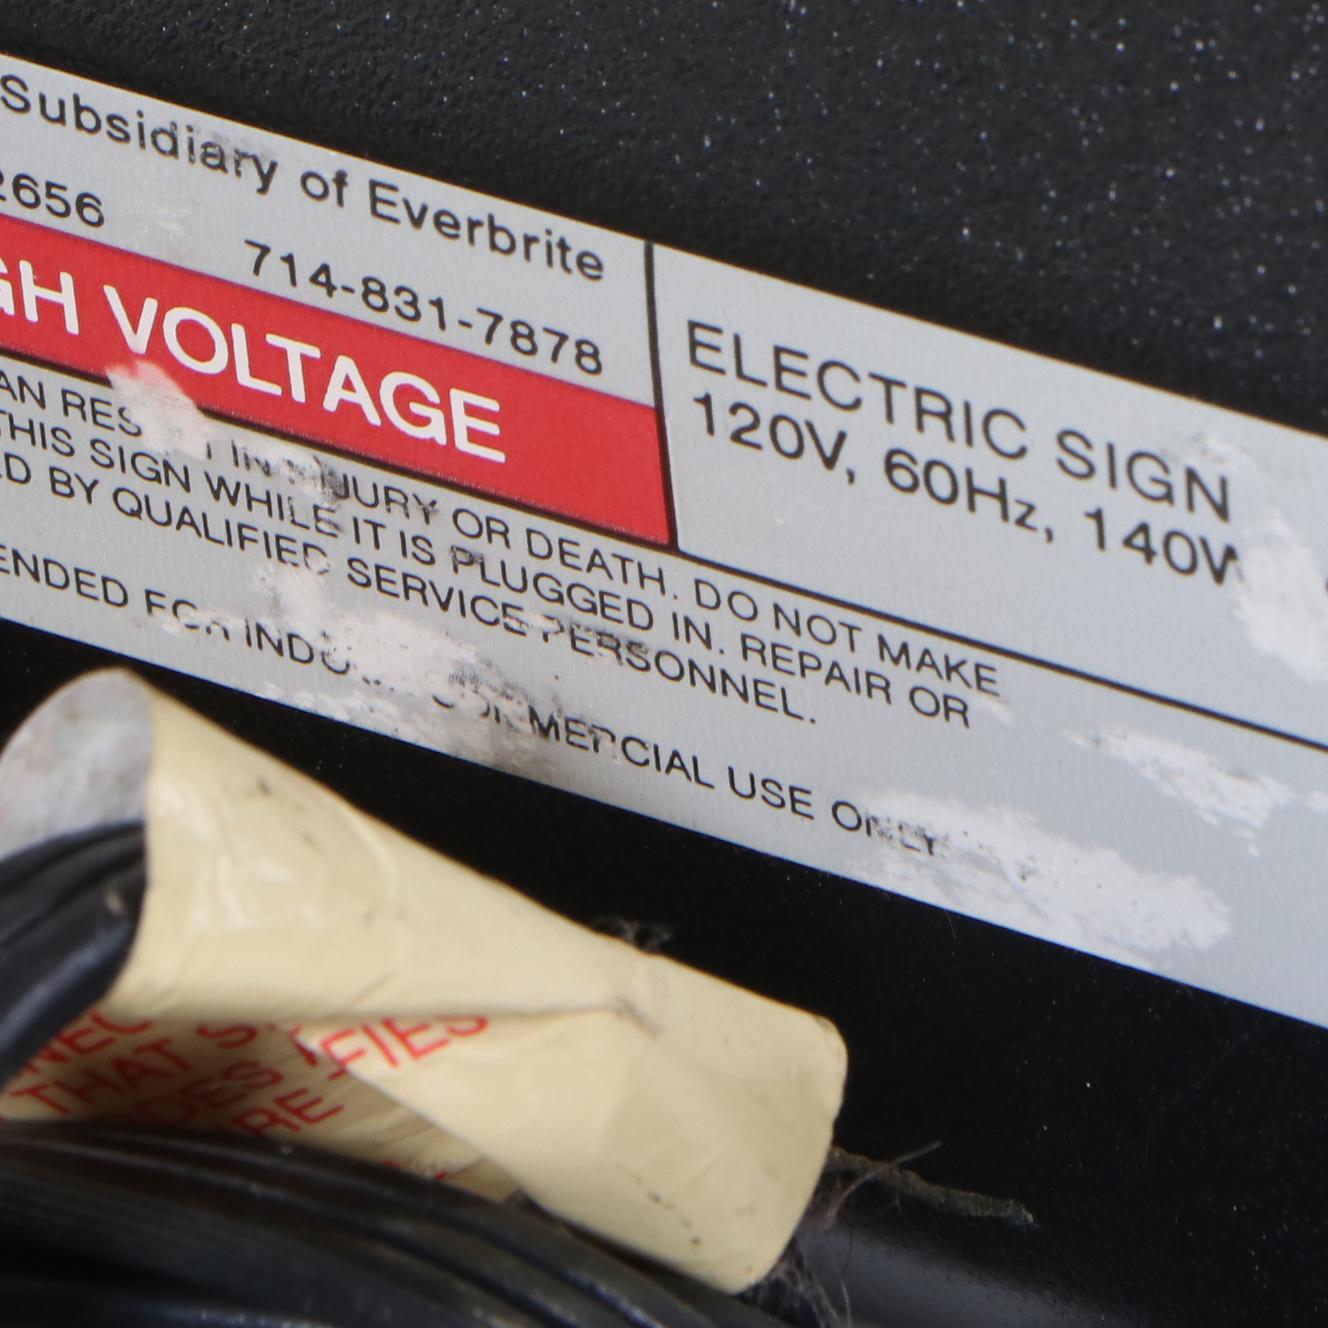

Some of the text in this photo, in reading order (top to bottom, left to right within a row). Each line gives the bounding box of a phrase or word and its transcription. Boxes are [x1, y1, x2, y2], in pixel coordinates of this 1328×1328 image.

[0, 74, 278, 194] Subsidiary
[300, 169, 348, 207] of
[368, 178, 605, 282] Everbrite
[103, 284, 506, 465] VOLTAGE
[244, 239, 603, 377] 714-831-7878
[687, 320, 1230, 522] ELECTRIC SIGN
[693, 393, 856, 485] 120V,
[883, 448, 1055, 543] 60Hz,
[48, 466, 100, 505] BY
[112, 487, 332, 576] QUALIFIED
[346, 556, 528, 637] SERVICE
[543, 614, 817, 725] PERSONNEL.
[90, 438, 191, 495] SIGN
[204, 472, 342, 538] WHILE
[352, 515, 386, 552] IT
[400, 529, 436, 567] IS
[450, 545, 654, 632] PLUGGED
[672, 612, 725, 655] IN.
[740, 632, 892, 705] REPAIR
[909, 686, 970, 728] OR
[453, 508, 510, 550] OR
[527, 527, 678, 600] DEATH.
[694, 579, 758, 622] DO
[773, 603, 862, 653] NOT
[877, 634, 1001, 697] MAKE
[727, 766, 815, 820] USE
